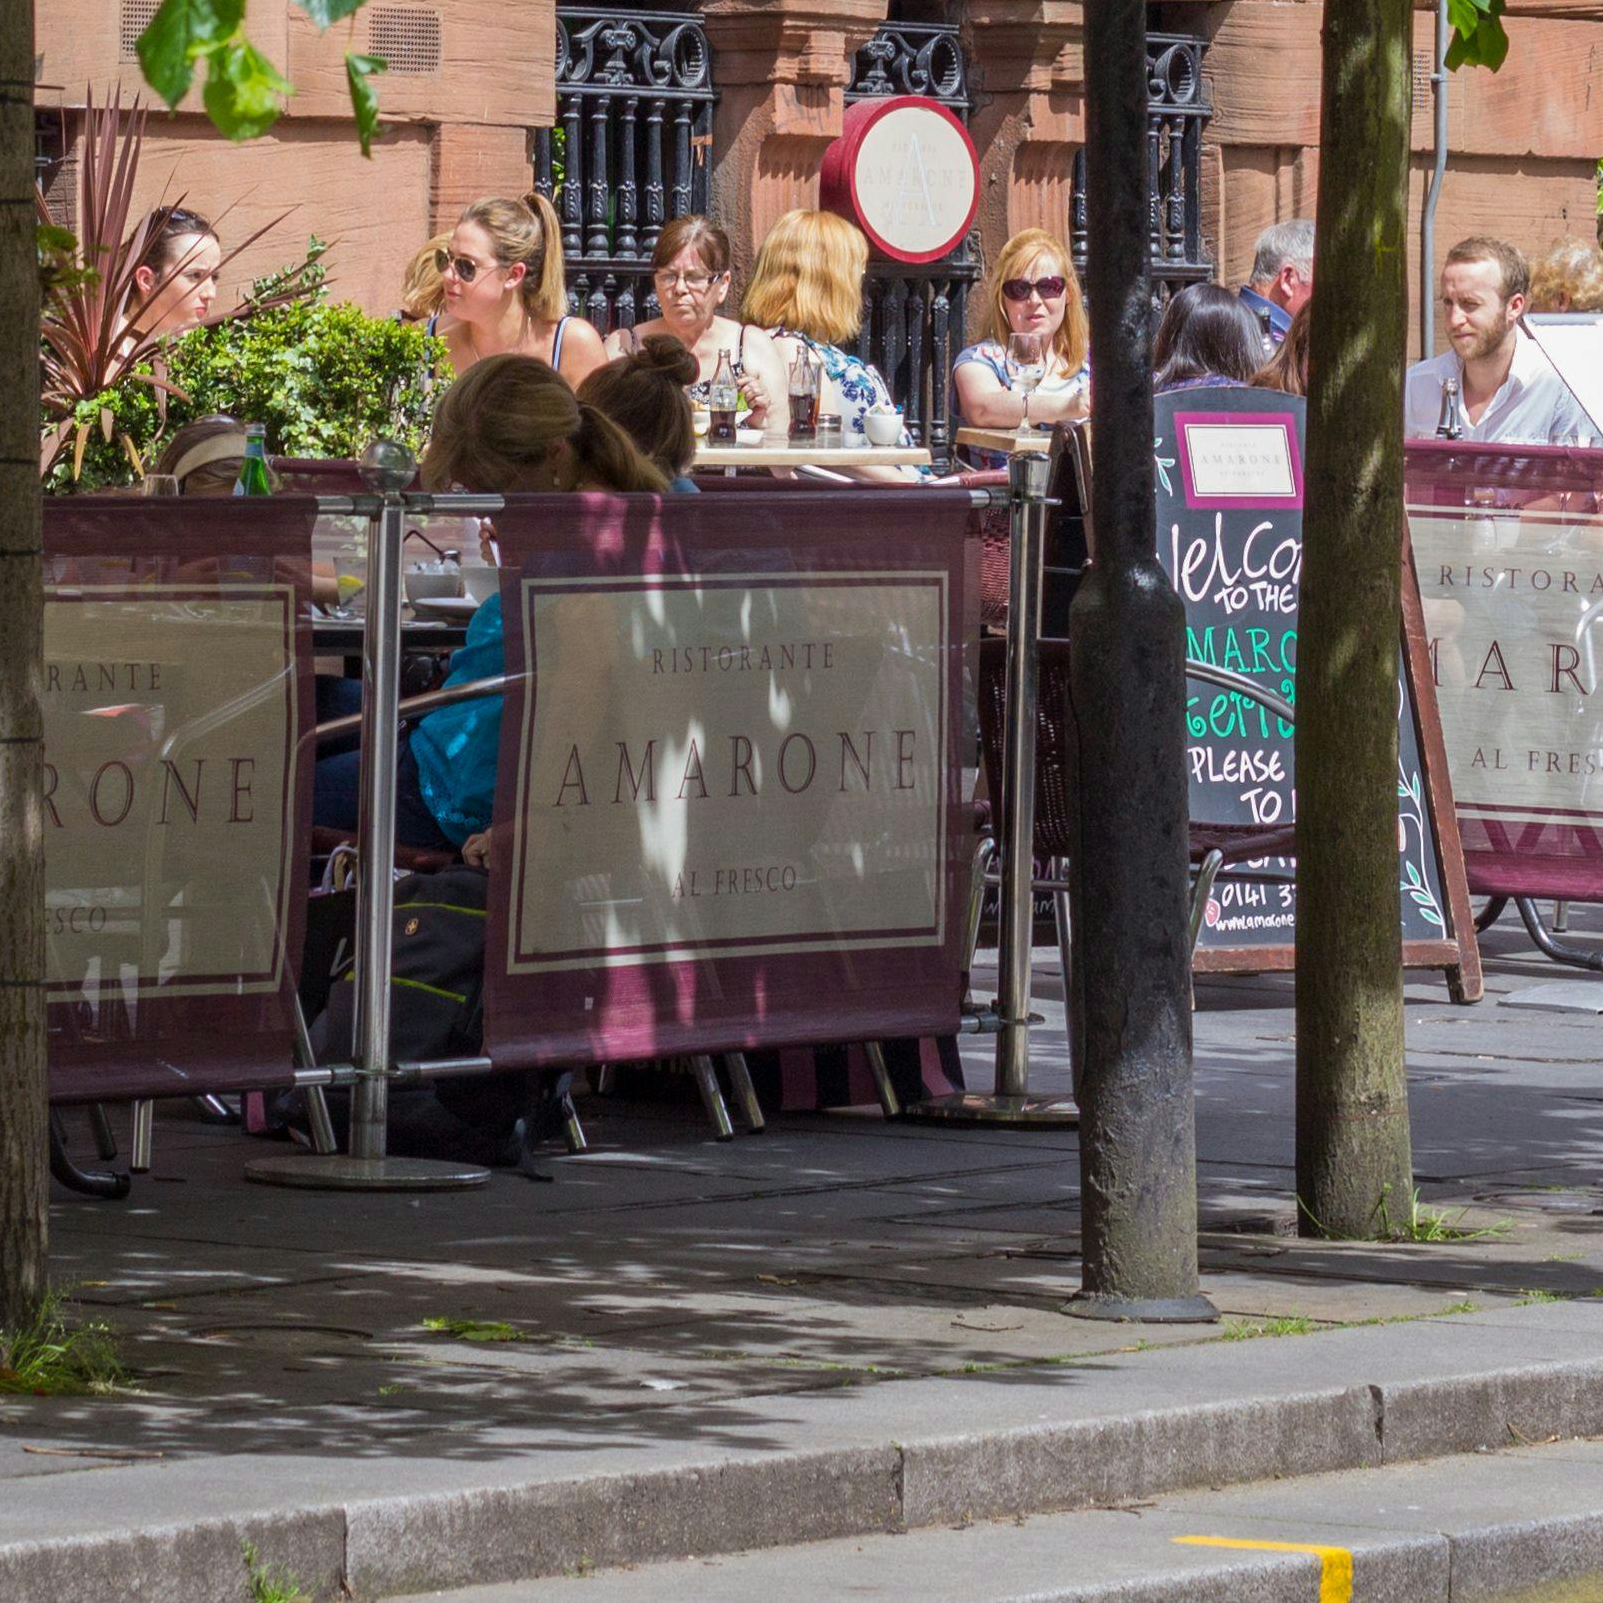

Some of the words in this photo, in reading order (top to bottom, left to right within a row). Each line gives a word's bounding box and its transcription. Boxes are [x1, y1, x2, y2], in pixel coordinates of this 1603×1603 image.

[1213, 586, 1249, 614] TO
[1249, 581, 1297, 613] THE
[652, 643, 835, 674] RISTORANTE
[48, 663, 161, 692] RANTE
[555, 730, 917, 807] AMARONE
[1187, 746, 1285, 783] PLEASE
[1471, 749, 1508, 771] AL
[1240, 788, 1282, 824] TO
[671, 869, 700, 898] AL
[715, 865, 797, 894] FRESCO
[1222, 884, 1267, 908] 0141
